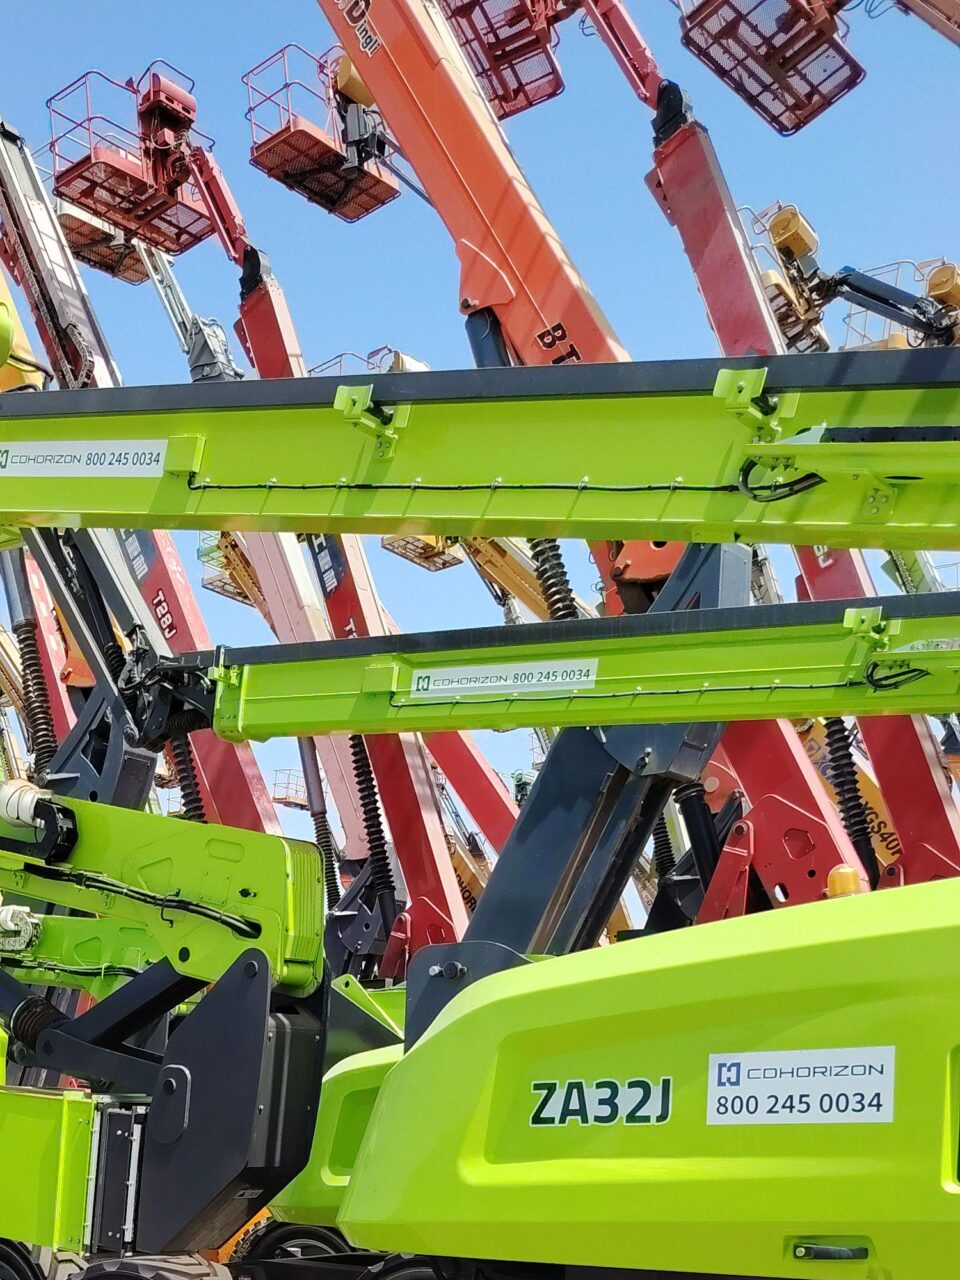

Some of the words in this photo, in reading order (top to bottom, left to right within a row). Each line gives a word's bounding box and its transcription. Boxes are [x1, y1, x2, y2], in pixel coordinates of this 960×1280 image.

[85, 452, 106, 466] 800
[108, 452, 129, 466] 245
[132, 451, 161, 466] 0034
[152, 589, 177, 639] T28J
[433, 675, 508, 687] CDHORIZON
[512, 672, 534, 684] 800
[536, 670, 558, 683] 245
[561, 669, 591, 682] 0034
[747, 1063, 884, 1080] CDHORIZON
[530, 1077, 672, 1126] ZA32J
[716, 1096, 759, 1115] 800
[766, 1094, 811, 1115] 245
[819, 1092, 883, 1113] 0034
